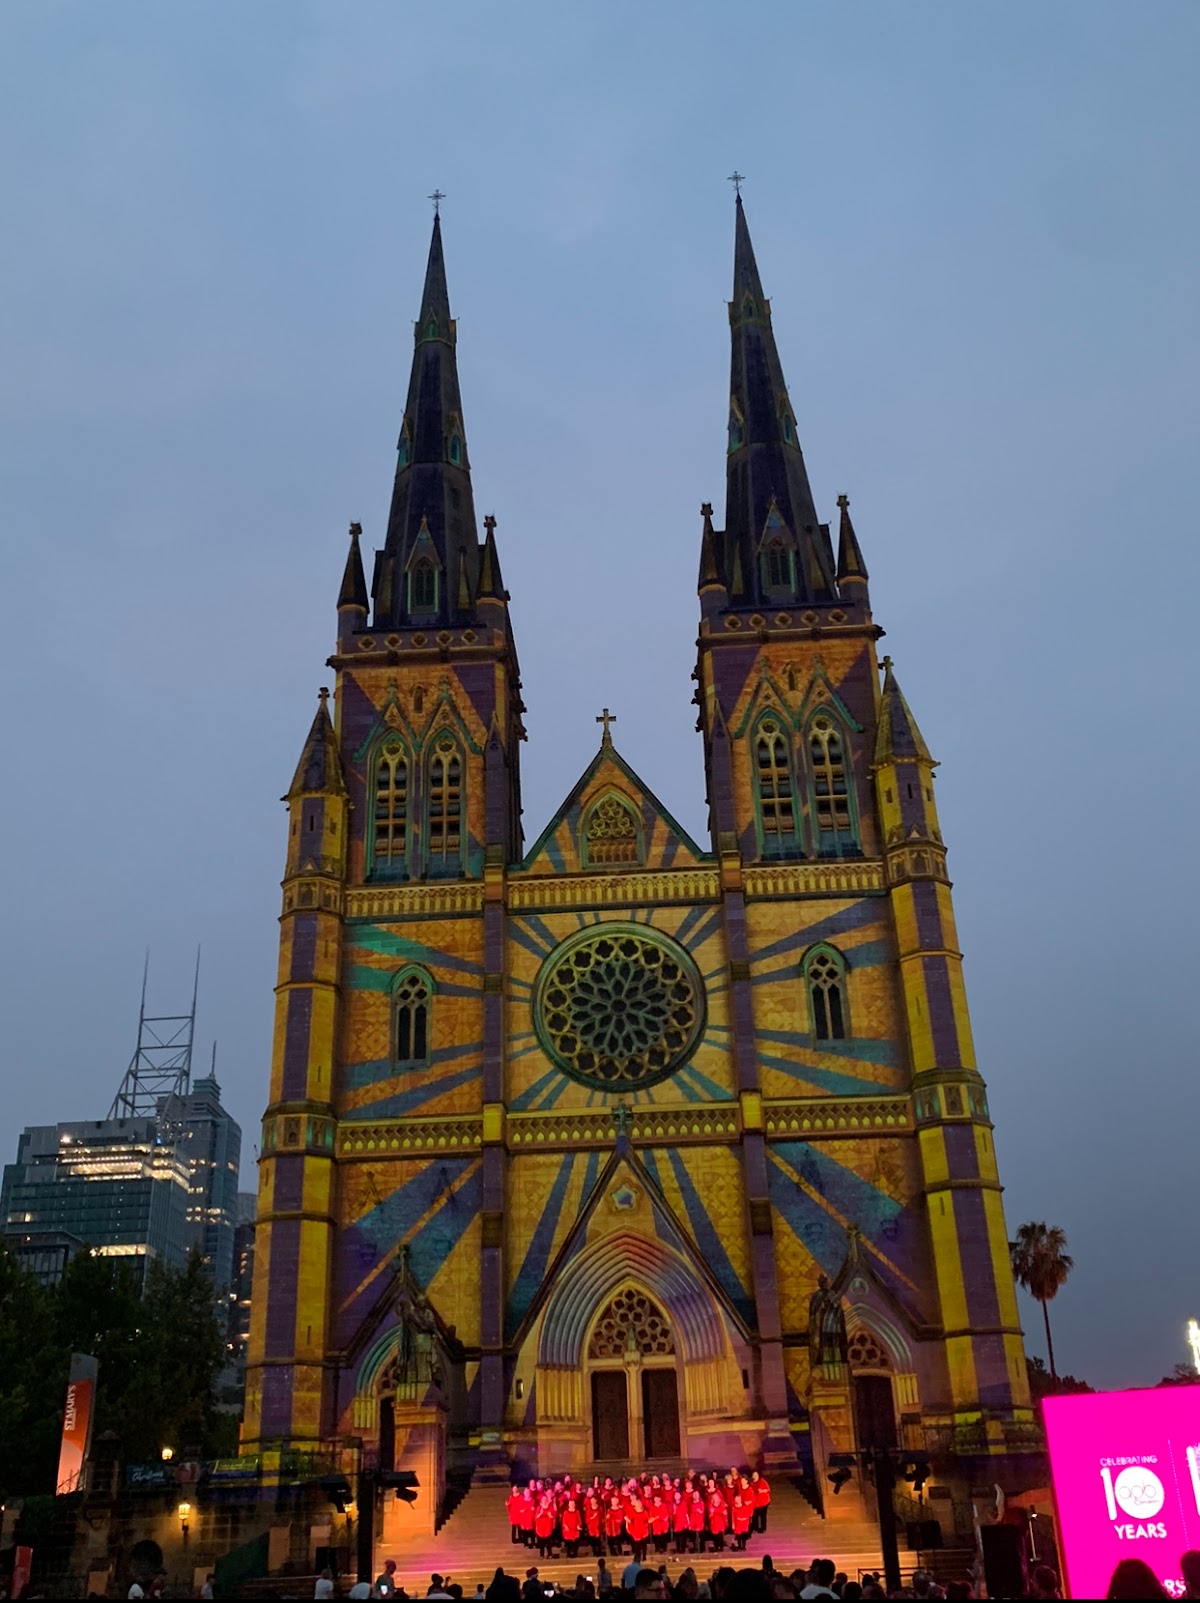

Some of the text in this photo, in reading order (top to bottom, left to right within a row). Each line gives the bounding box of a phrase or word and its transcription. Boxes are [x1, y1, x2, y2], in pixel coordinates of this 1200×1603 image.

[1100, 1455, 1158, 1466] CELEBRATING
[1100, 1466, 1165, 1520] 10
[1113, 1523, 1168, 1540] YEARS
